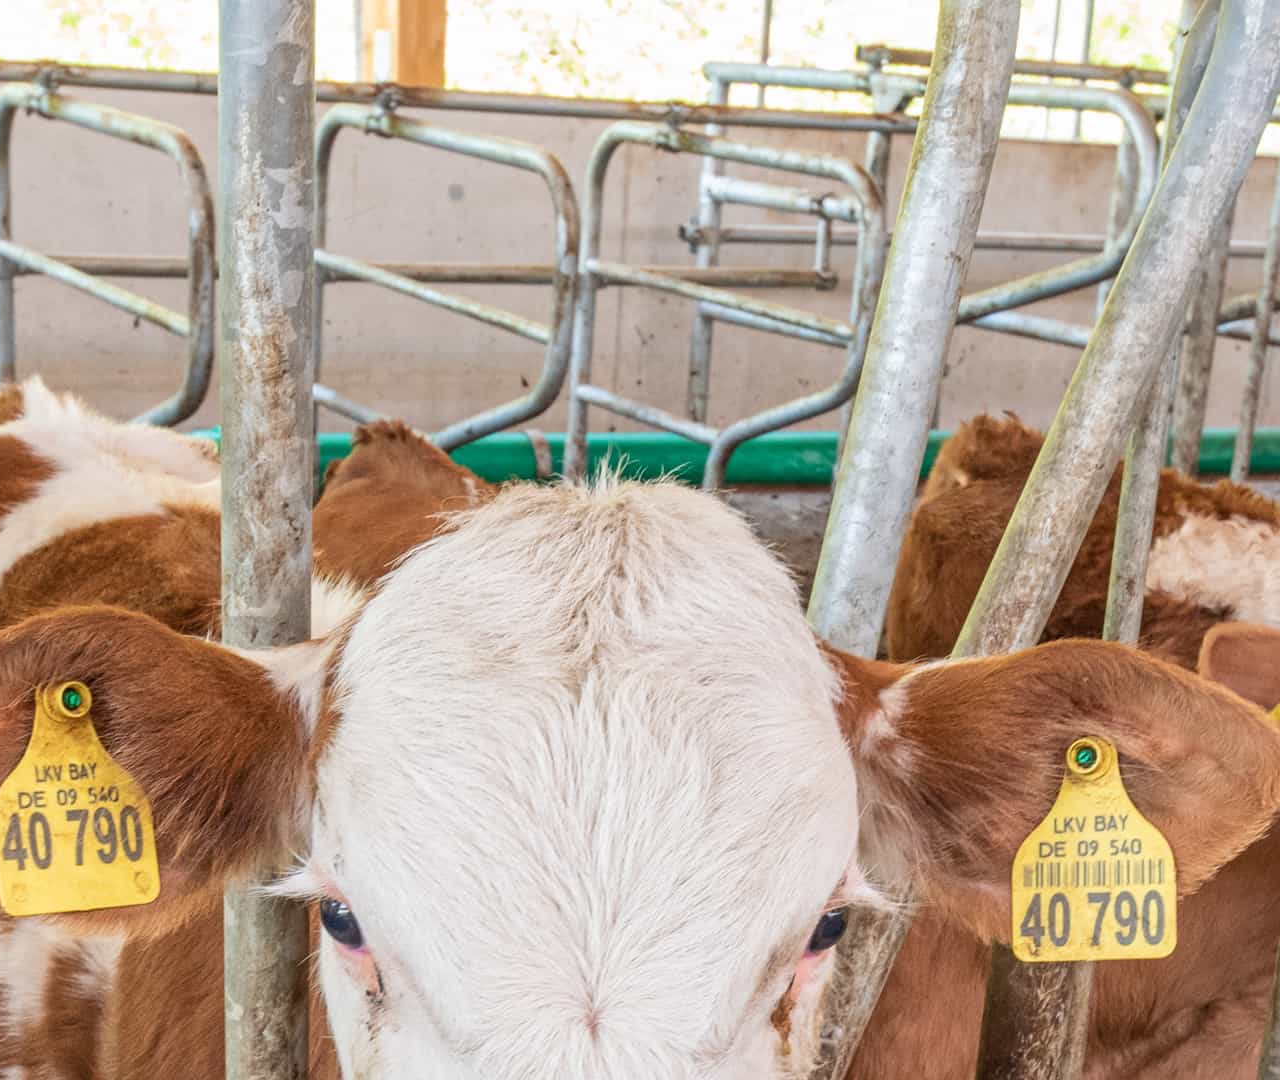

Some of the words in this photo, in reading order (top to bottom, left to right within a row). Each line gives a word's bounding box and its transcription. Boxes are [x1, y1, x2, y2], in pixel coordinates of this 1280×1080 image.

[35, 765, 63, 783] LKV
[69, 763, 97, 781] BAY
[18, 791, 47, 809] DE
[57, 789, 78, 806] 09
[88, 786, 119, 804] 540
[1053, 816, 1086, 834] LKV
[1094, 815, 1129, 832] BAY
[2, 812, 53, 871] 40
[66, 806, 143, 866] 790
[1039, 842, 1067, 858] DE
[1077, 841, 1098, 857] 09
[1110, 839, 1142, 856] 540
[1020, 893, 1071, 948] 40
[1087, 890, 1165, 947] 790
